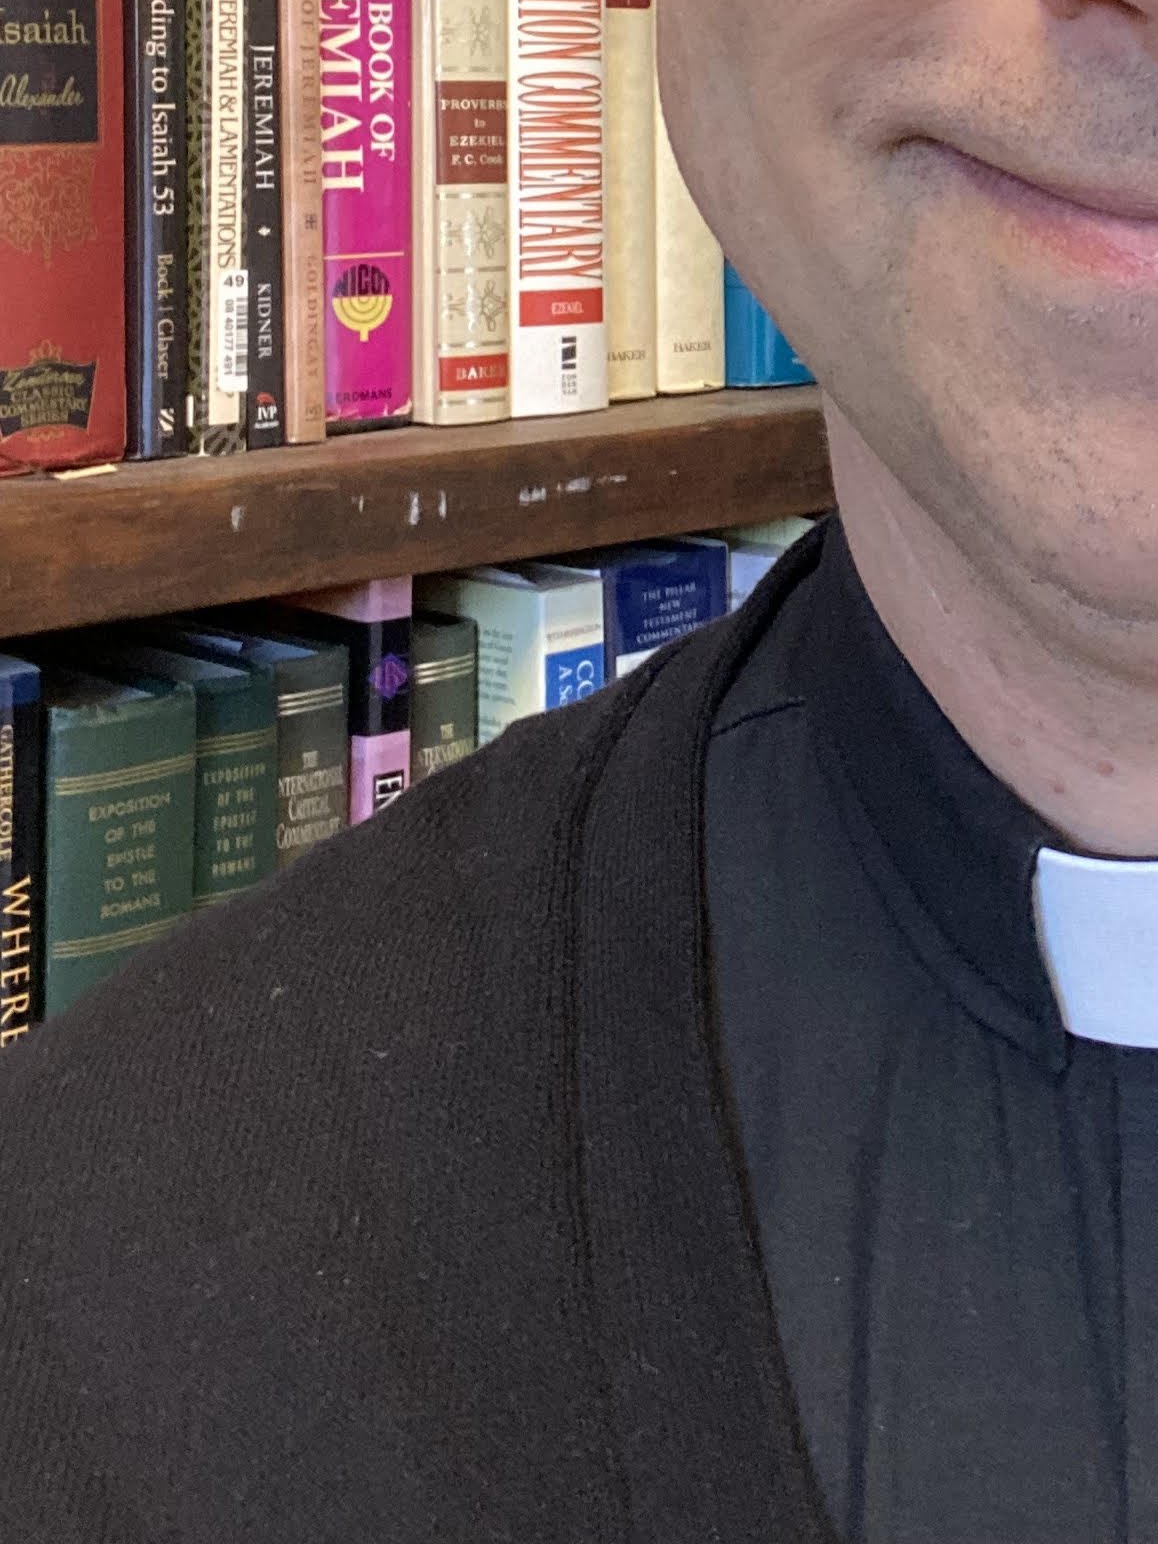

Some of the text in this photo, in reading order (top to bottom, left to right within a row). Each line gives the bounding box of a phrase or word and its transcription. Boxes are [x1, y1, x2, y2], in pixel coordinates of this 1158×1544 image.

[301, 0, 314, 34] OF
[367, 1, 395, 101] BOOK
[0, 73, 84, 110] Alexander
[151, 64, 172, 94] to
[218, 95, 237, 110] &
[301, 43, 318, 185] JEREMIAH
[250, 44, 276, 192] JEREMIAH
[474, 117, 486, 129] to
[151, 102, 177, 177] Isaiah
[369, 112, 396, 162] OF
[449, 134, 505, 148] EZEKIEL
[517, 70, 603, 281] COMMENTARY
[152, 185, 175, 216] 53
[217, 116, 240, 270] LAMENTATIONS
[224, 274, 245, 289] 49
[156, 254, 175, 380] Bock Glaser
[256, 283, 273, 359] KIDNER
[672, 340, 713, 354] BAKER
[257, 405, 278, 421] IVP
[203, 762, 267, 787] EXPOSITION
[88, 791, 171, 822] EXPOSITION
[213, 810, 257, 833] EPISTLE
[105, 818, 157, 844] OF THE
[216, 833, 254, 853] TO THE
[106, 843, 156, 868] EPISTLE
[104, 868, 157, 893] TO THE
[100, 892, 162, 921] ROMANS
[0, 873, 32, 1049] WHERE
